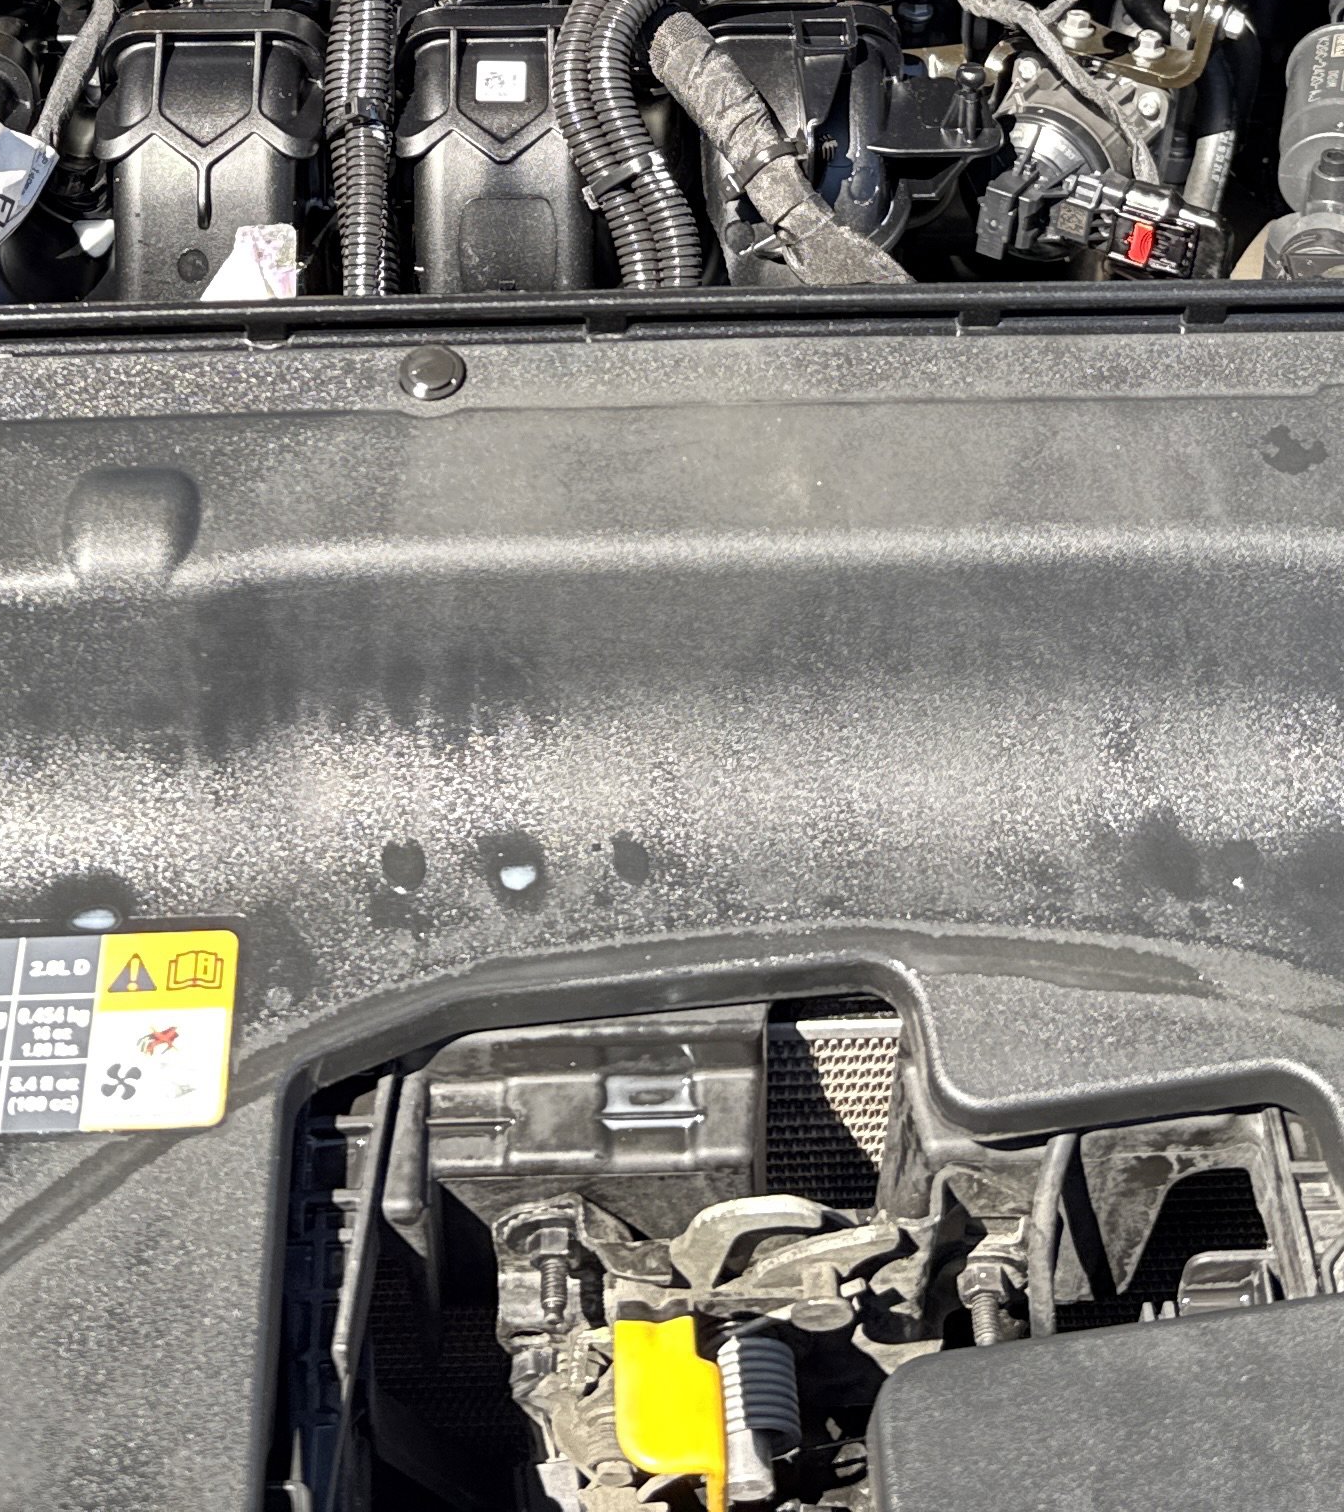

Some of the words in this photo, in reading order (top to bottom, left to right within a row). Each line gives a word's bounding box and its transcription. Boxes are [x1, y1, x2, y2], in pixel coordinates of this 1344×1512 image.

[73, 958, 91, 976] D
[66, 1006, 90, 1028] kg
[52, 1027, 73, 1041] oz
[55, 1078, 80, 1092] oz
